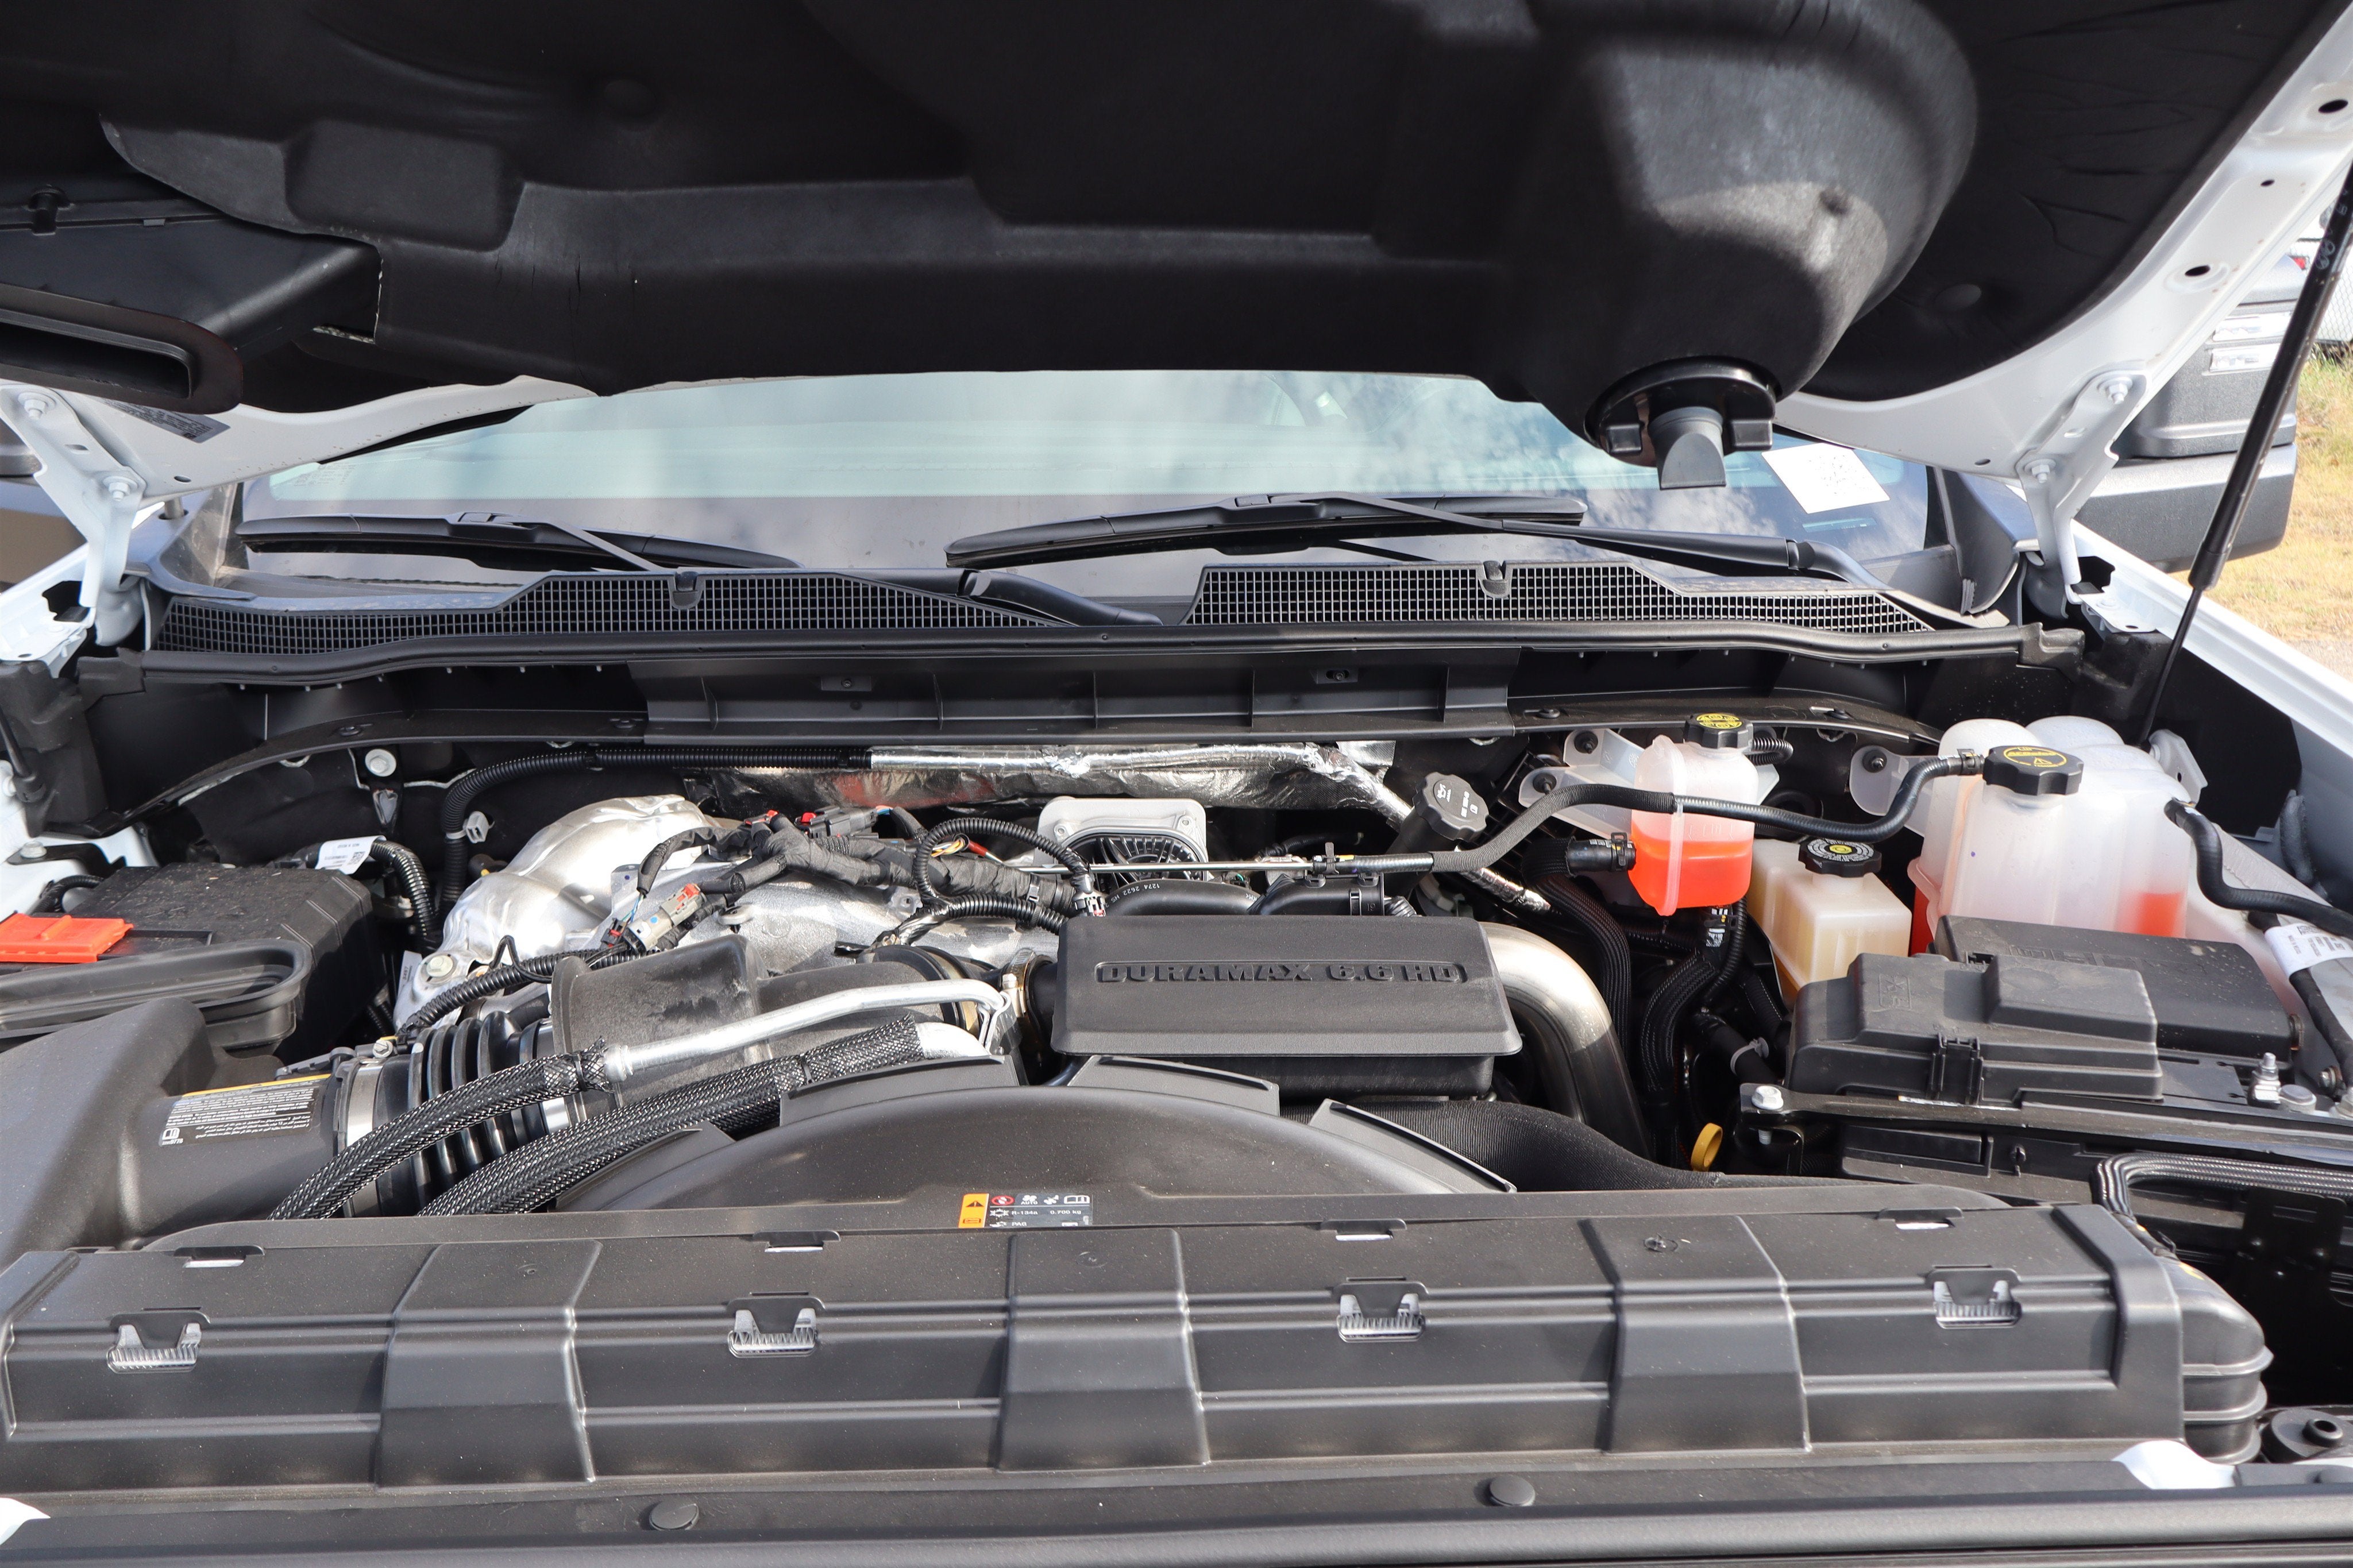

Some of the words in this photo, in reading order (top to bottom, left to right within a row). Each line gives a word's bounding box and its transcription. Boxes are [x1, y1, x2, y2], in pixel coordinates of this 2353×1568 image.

[1096, 963, 1313, 983] DURAMAX
[1325, 964, 1394, 982] 6.6
[1401, 964, 1462, 983] HD
